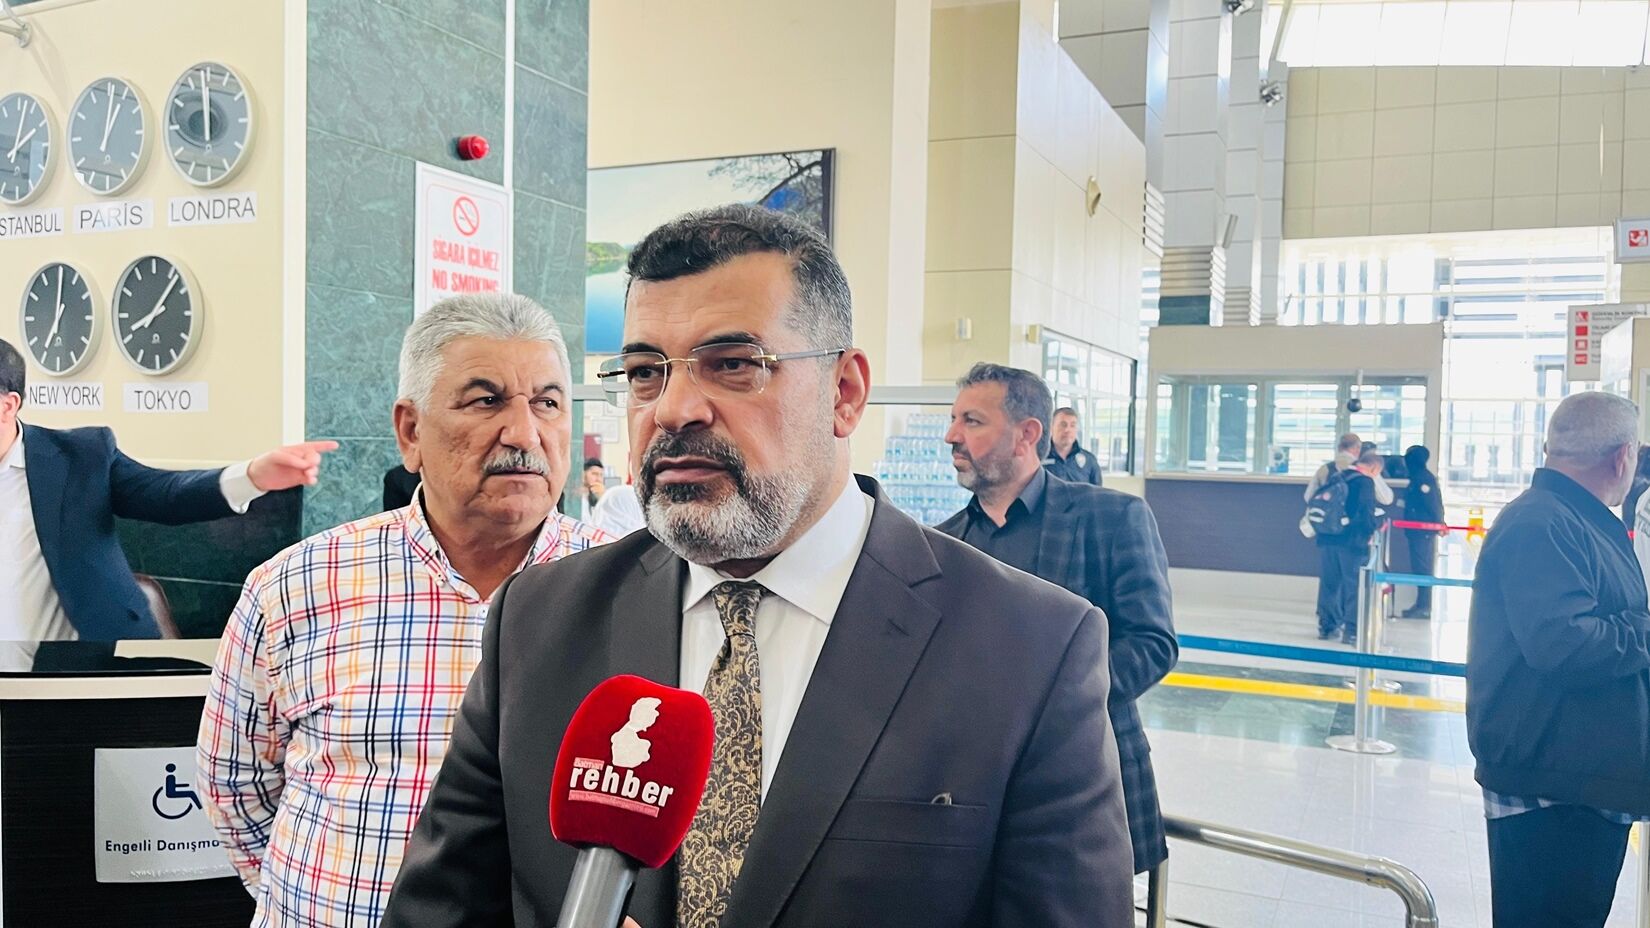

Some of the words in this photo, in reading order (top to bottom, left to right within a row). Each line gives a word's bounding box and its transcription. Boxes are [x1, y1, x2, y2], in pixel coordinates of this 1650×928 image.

[80, 203, 143, 229] PARİS
[170, 197, 256, 222] LONDRA
[0, 213, 62, 236] STANBUL
[432, 268, 448, 290] NO
[29, 385, 59, 405] NEW
[62, 386, 101, 406] YORK
[134, 390, 192, 410] TOKYO
[569, 765, 674, 807] rehber
